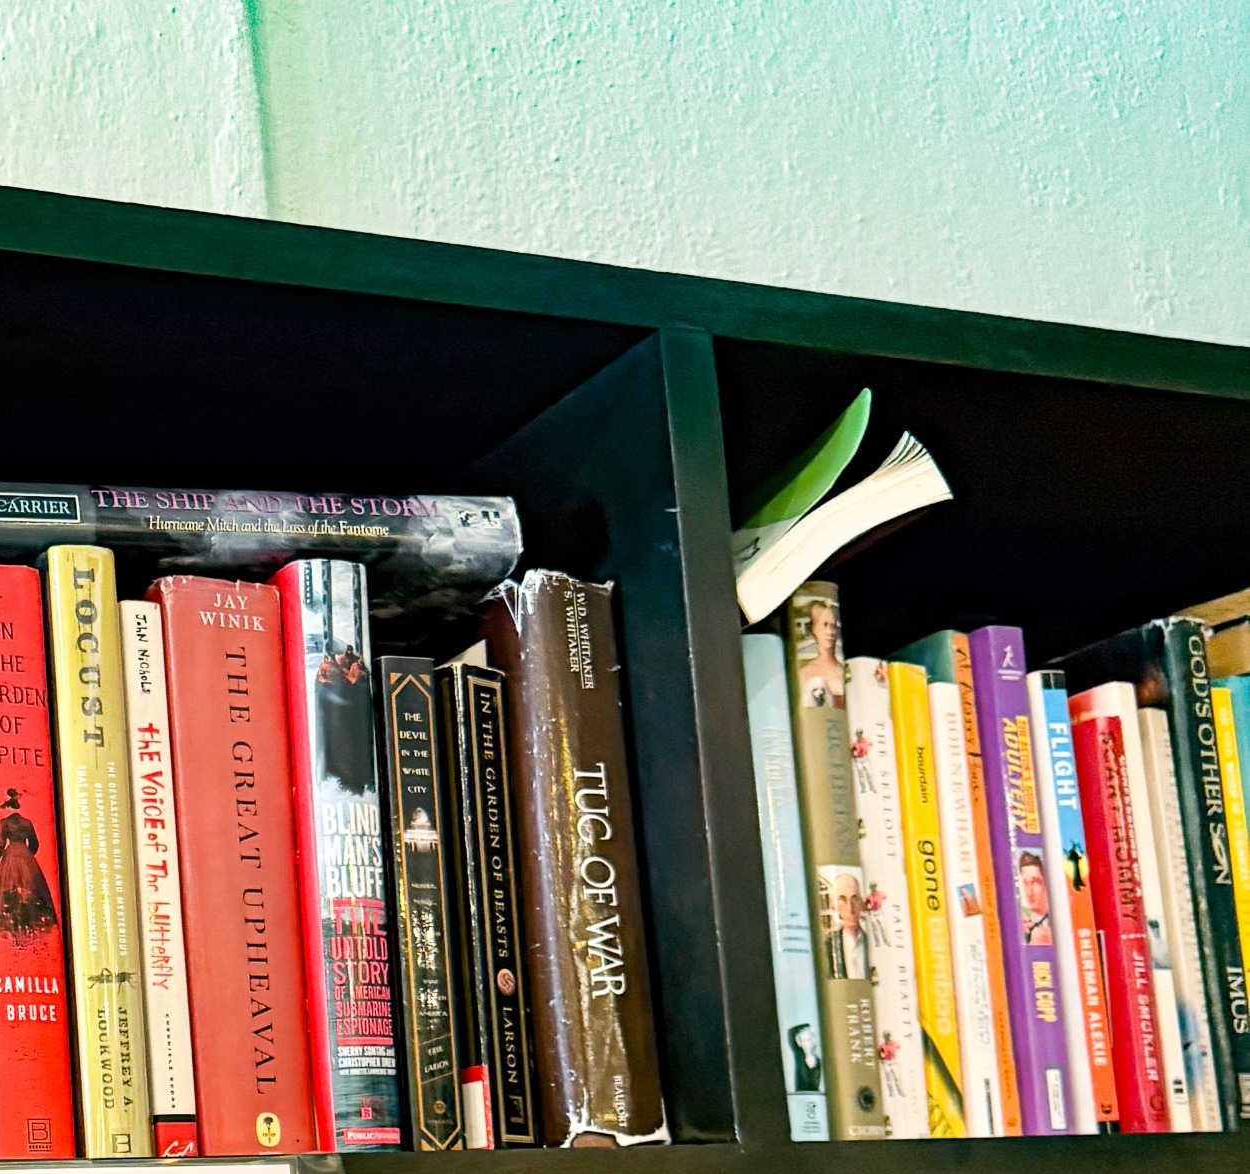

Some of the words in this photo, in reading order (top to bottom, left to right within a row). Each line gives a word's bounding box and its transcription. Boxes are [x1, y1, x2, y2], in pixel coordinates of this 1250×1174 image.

[199, 611, 266, 632] WINIK
[212, 592, 248, 610] JAY
[72, 567, 105, 748] LOCUST
[225, 646, 251, 724] THE
[0, 716, 24, 734] OF
[1048, 722, 1078, 810] FLIGHT
[232, 741, 261, 869] GREAT
[322, 804, 380, 835] BLIND
[573, 762, 613, 846] TUG
[325, 835, 382, 866] MAN'S
[326, 866, 383, 899] BLUFF
[580, 855, 617, 909] OF
[585, 913, 628, 1000] WAR
[1077, 928, 1099, 1006] SHERMAN
[6, 1004, 57, 1022] BRUCE
[242, 887, 276, 1095] UPHEAVAL
[1083, 1012, 1107, 1067] ALEXIE
